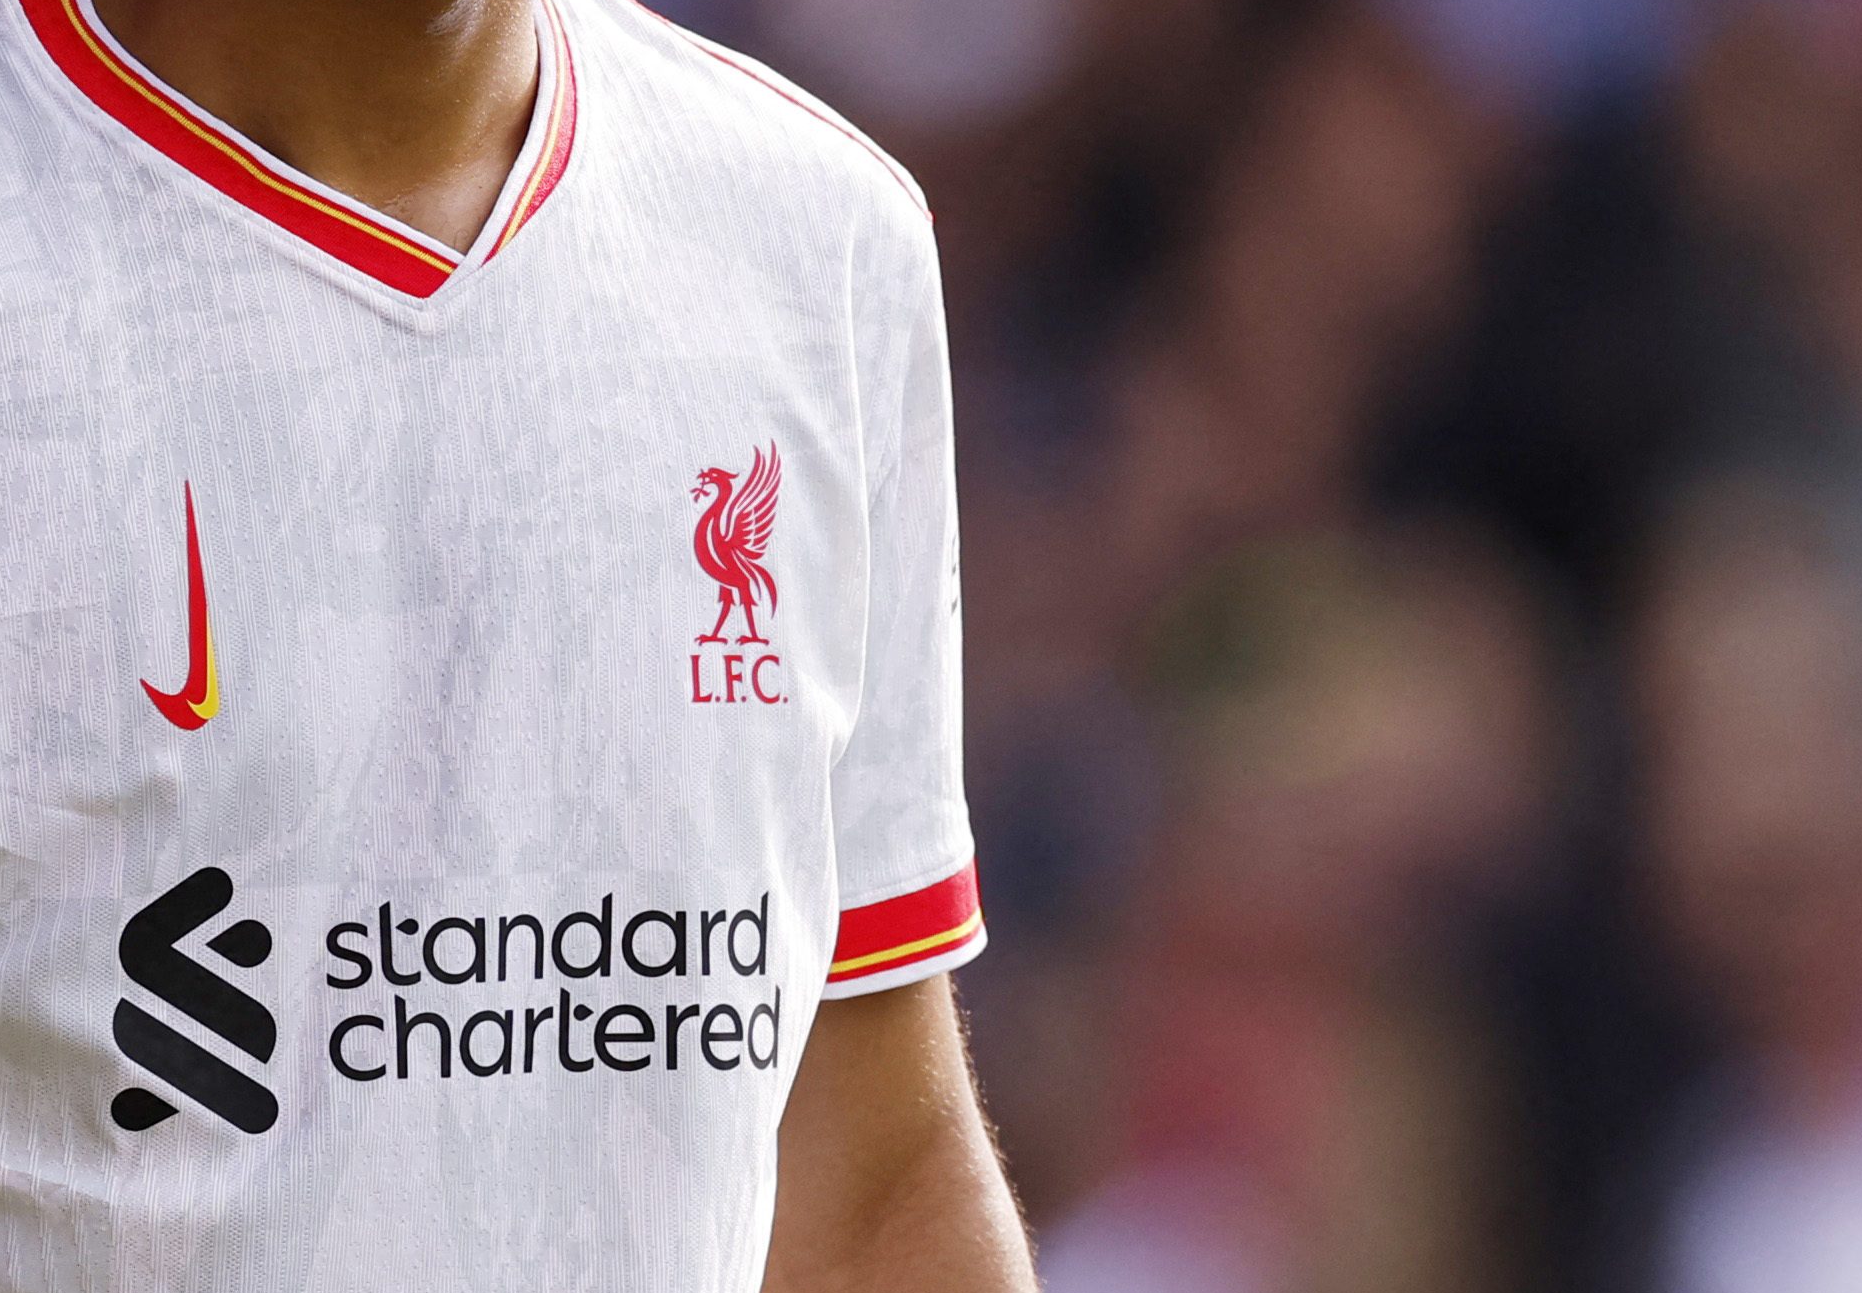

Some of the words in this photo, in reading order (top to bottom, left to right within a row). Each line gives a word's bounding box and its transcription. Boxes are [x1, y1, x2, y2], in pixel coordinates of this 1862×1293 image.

[691, 655, 788, 704] L.F.C.
[326, 891, 769, 989] standard
[329, 986, 780, 1081] chartered
